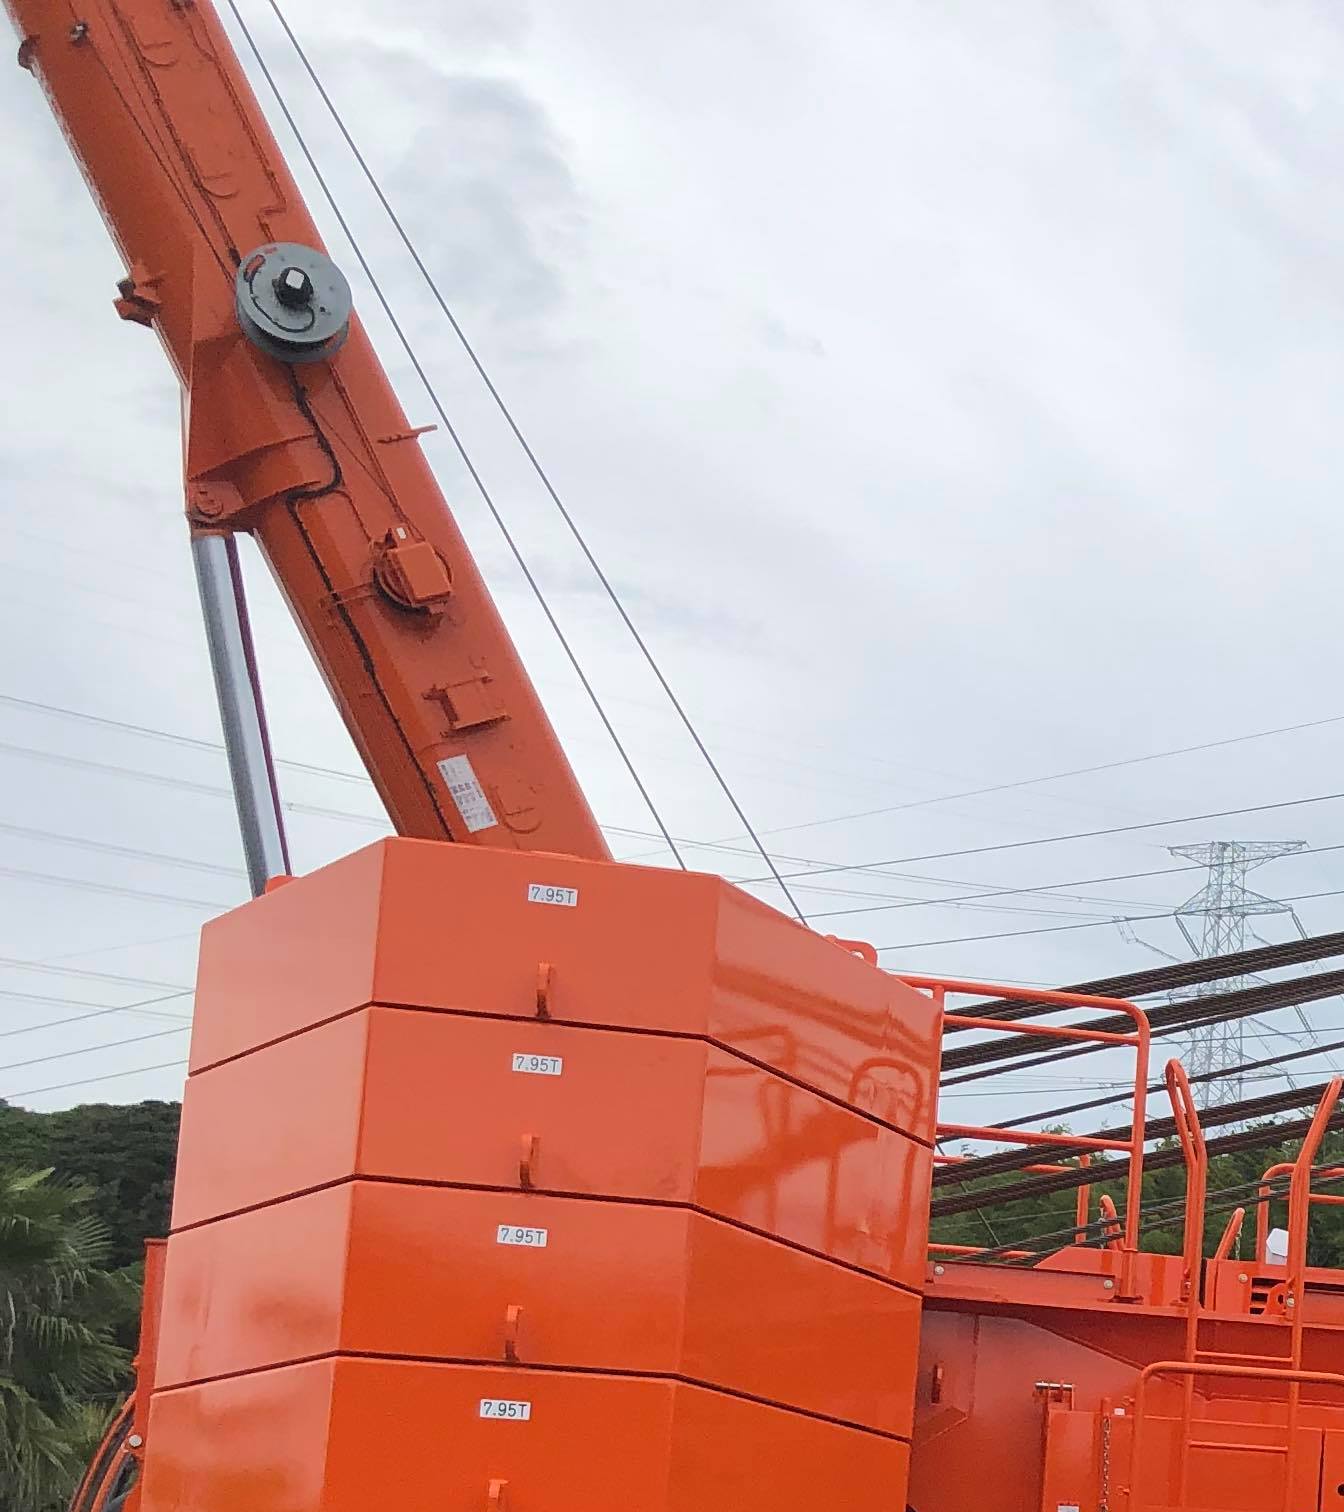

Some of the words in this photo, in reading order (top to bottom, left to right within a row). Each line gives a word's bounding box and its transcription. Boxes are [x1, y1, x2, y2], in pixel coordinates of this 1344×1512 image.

[531, 885, 575, 904] 7.95T
[515, 1055, 559, 1073] 7.95T
[500, 1227, 545, 1245] 7.95T
[483, 1401, 528, 1418] 7.95T
